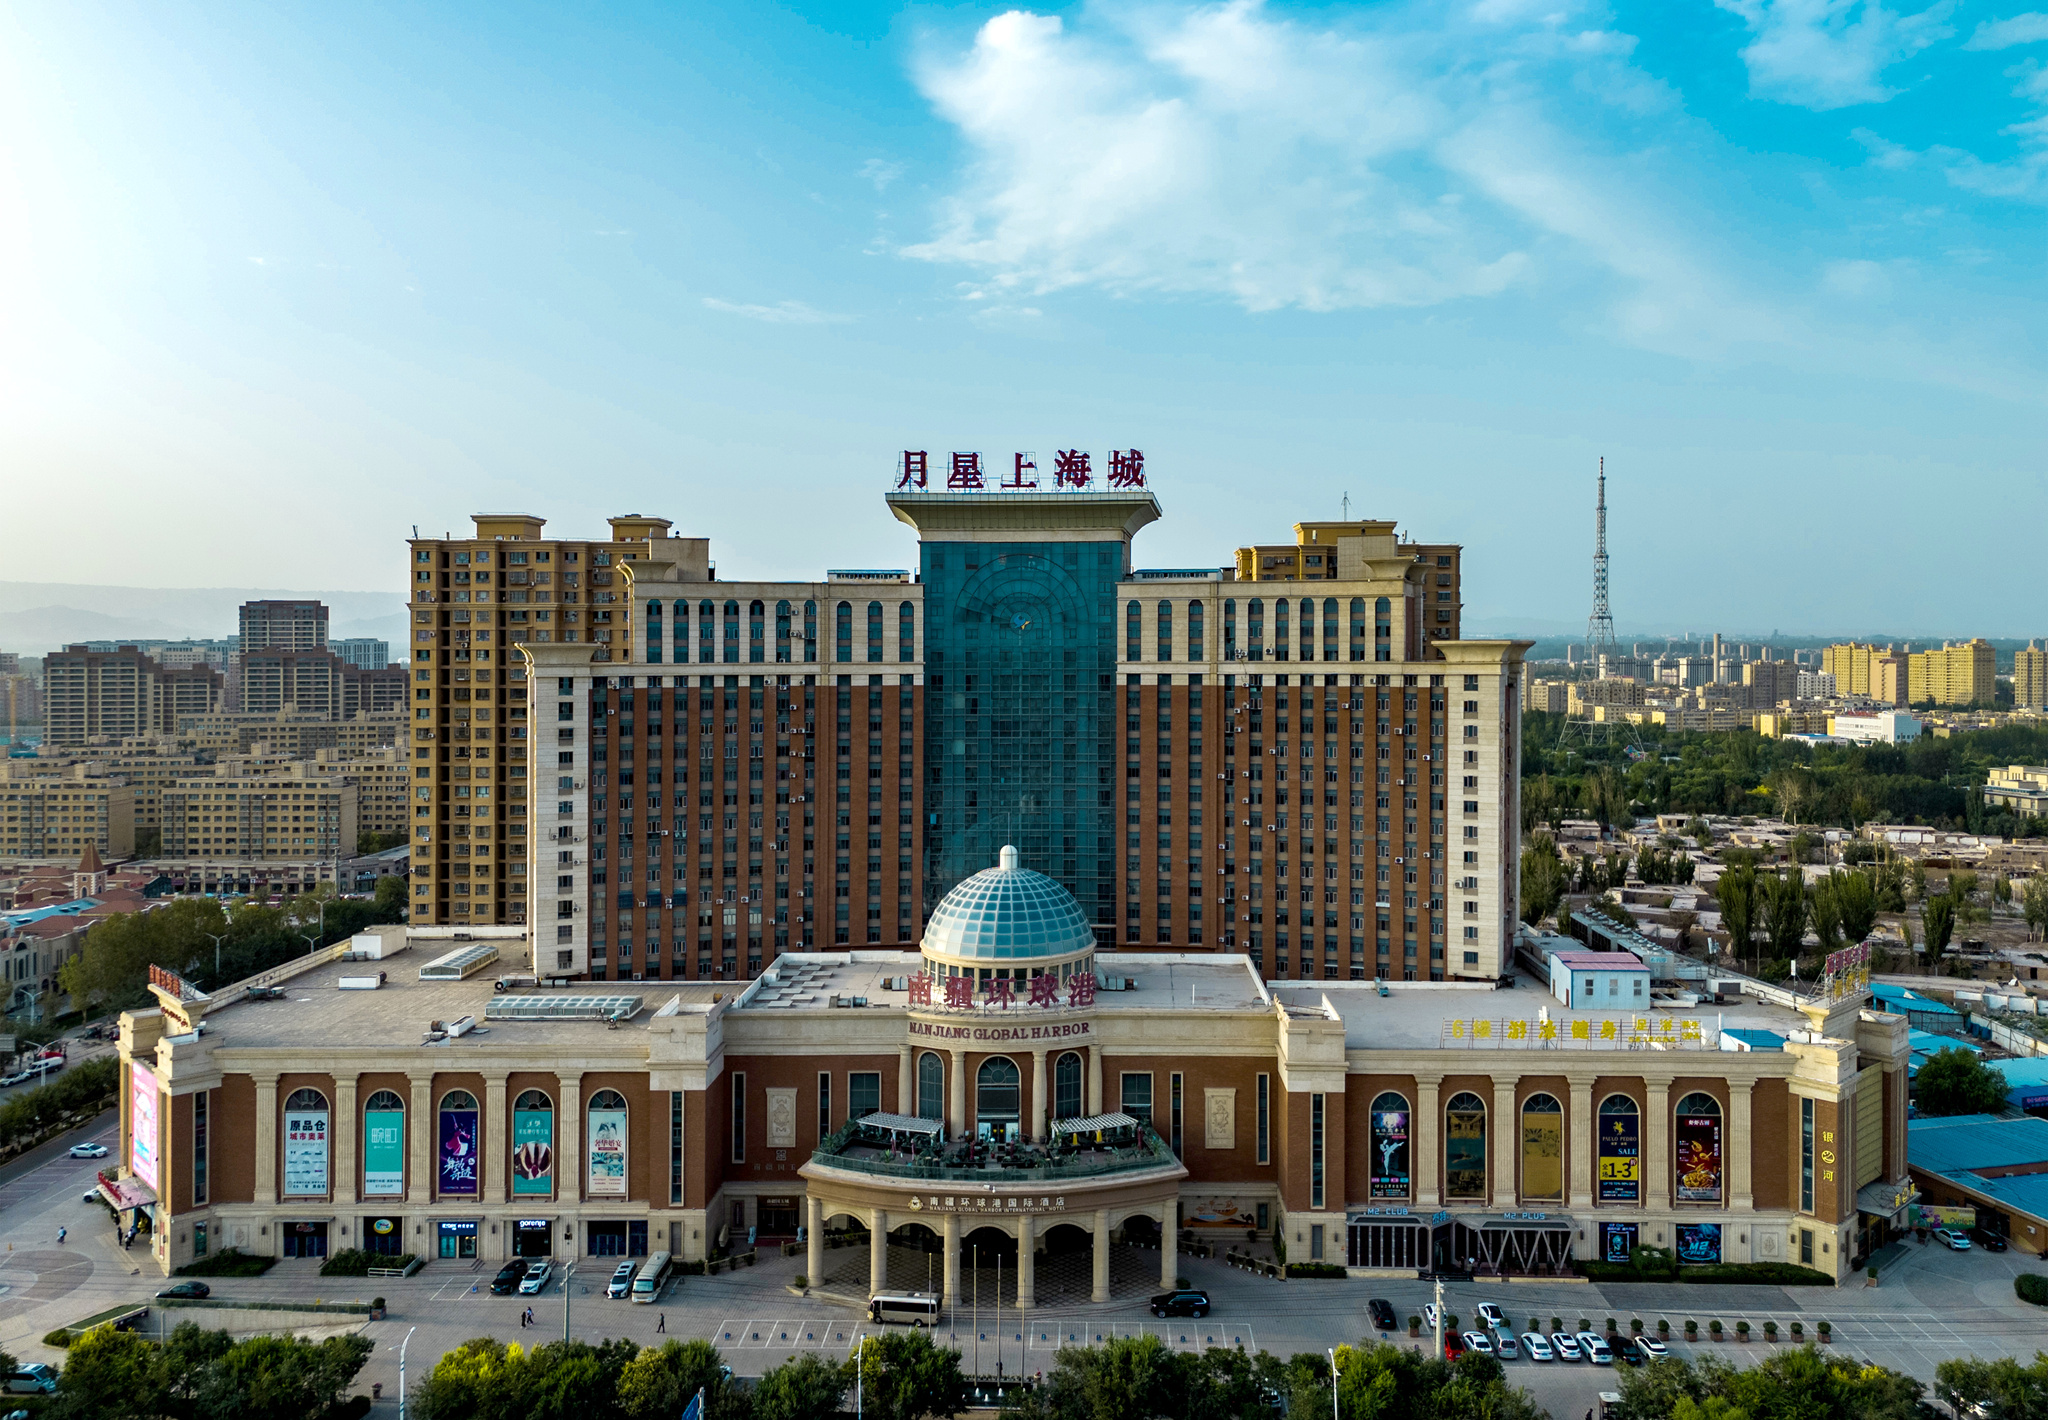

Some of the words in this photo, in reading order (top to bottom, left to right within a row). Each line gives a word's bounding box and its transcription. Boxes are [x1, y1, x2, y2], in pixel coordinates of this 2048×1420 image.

[898, 449, 1145, 488] 月星上海城
[907, 970, 1097, 1010] 南疆环球港
[909, 1022, 970, 1039] NANJIANG
[973, 1028, 1028, 1040] GLOBAL
[1031, 1022, 1090, 1039] HARBOR
[290, 1120, 326, 1131] 原品仓
[290, 1132, 325, 1140] 城市奥莱
[1608, 1162, 1632, 1178] 1-3
[930, 1196, 1065, 1208] 南疆环球港国际酒店
[1522, 1212, 1545, 1220] PLUS
[1689, 1241, 1710, 1251] M2
